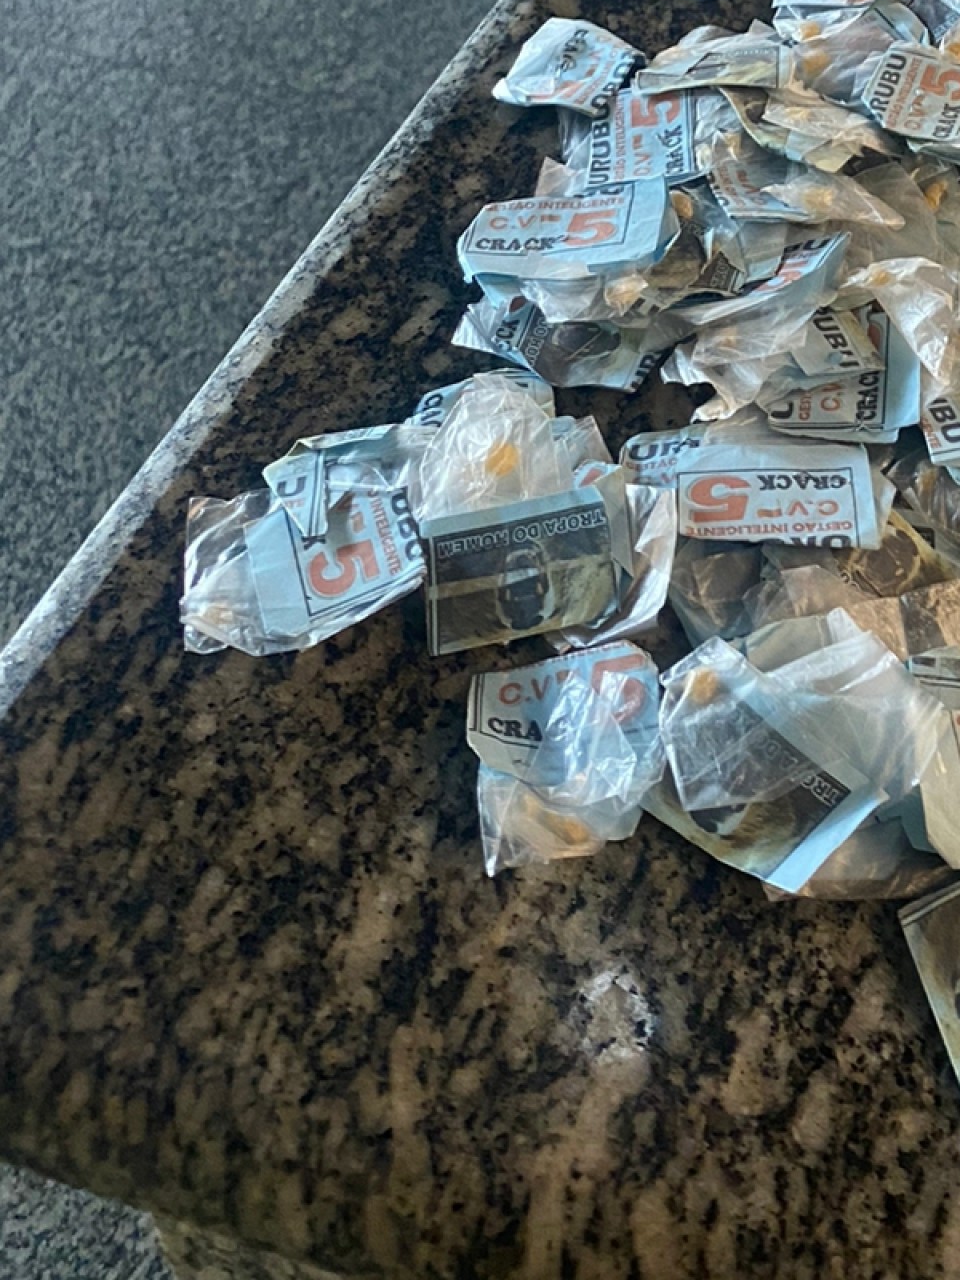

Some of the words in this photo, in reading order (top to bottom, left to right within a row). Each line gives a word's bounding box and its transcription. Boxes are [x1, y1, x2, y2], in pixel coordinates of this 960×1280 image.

[630, 93, 682, 129] 5
[565, 209, 618, 247] 5
[475, 235, 557, 252] CRACK
[758, 473, 849, 492] CRACK
[687, 473, 752, 524] 5
[787, 499, 840, 518] C.V
[513, 523, 541, 543] DO
[545, 509, 607, 537] TROPA
[435, 529, 509, 559] HOMEM
[307, 538, 381, 598] 5
[487, 716, 543, 742] CRA
